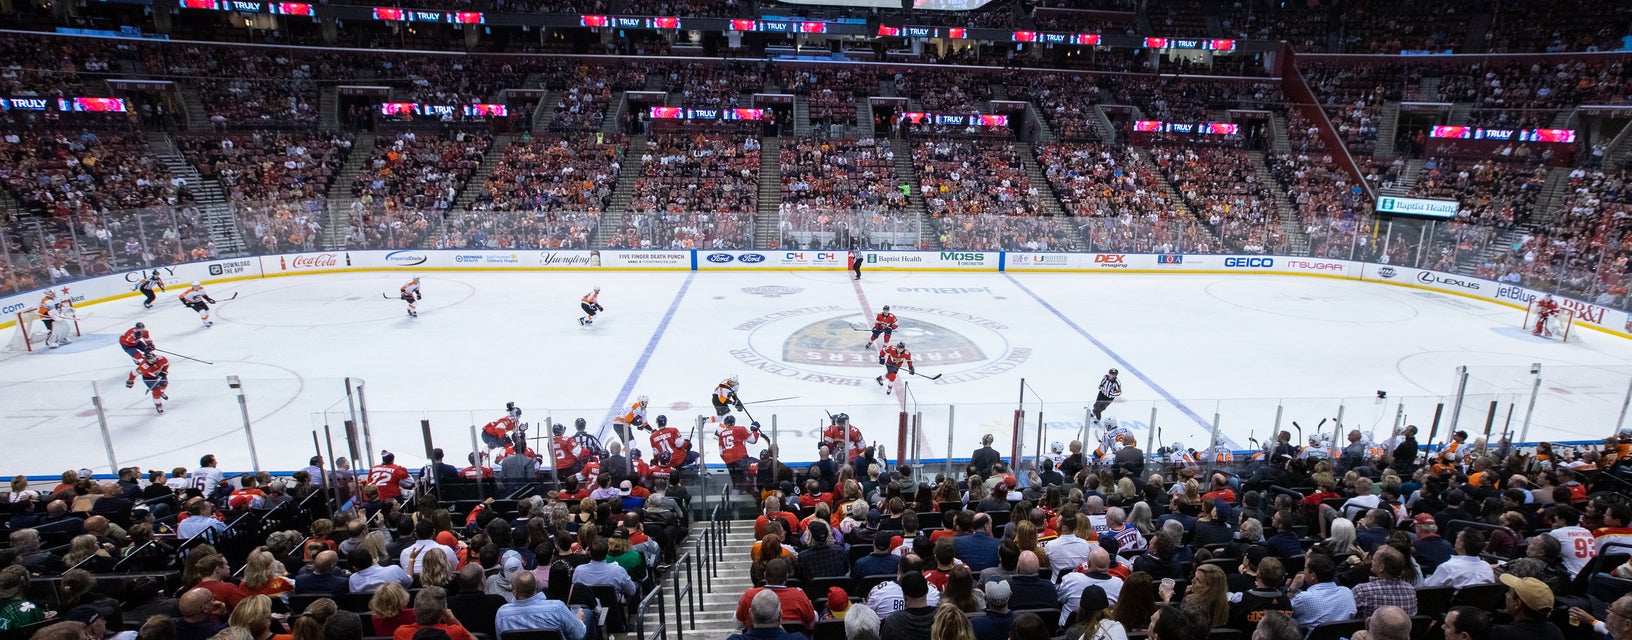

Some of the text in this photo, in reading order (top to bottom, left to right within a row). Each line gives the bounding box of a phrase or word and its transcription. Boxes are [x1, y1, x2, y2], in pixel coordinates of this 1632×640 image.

[233, 1, 260, 10] TRULY
[417, 12, 440, 20] TRULY
[618, 18, 640, 26] TRULY
[767, 22, 787, 30] TRULY
[1046, 34, 1065, 42] TRULY
[1178, 40, 1198, 48] TRULY
[10, 99, 47, 109] TRULY
[695, 110, 718, 118] TRULY
[943, 115, 963, 123] TRULY
[1173, 123, 1193, 131] TRULY
[1486, 129, 1514, 138] TRULY
[1396, 201, 1454, 213] Baptist Health
[539, 251, 591, 266] Yuengling
[878, 255, 922, 263] Baptist Health
[1094, 254, 1126, 263] DEX
[1224, 257, 1274, 268] GEICO
[223, 260, 250, 268] DOWNLOAD
[1436, 276, 1481, 290] LEXUS
[1494, 283, 1536, 302] jetBlue
[1561, 299, 1610, 325] BB&T
[1574, 538, 1597, 559] 93
